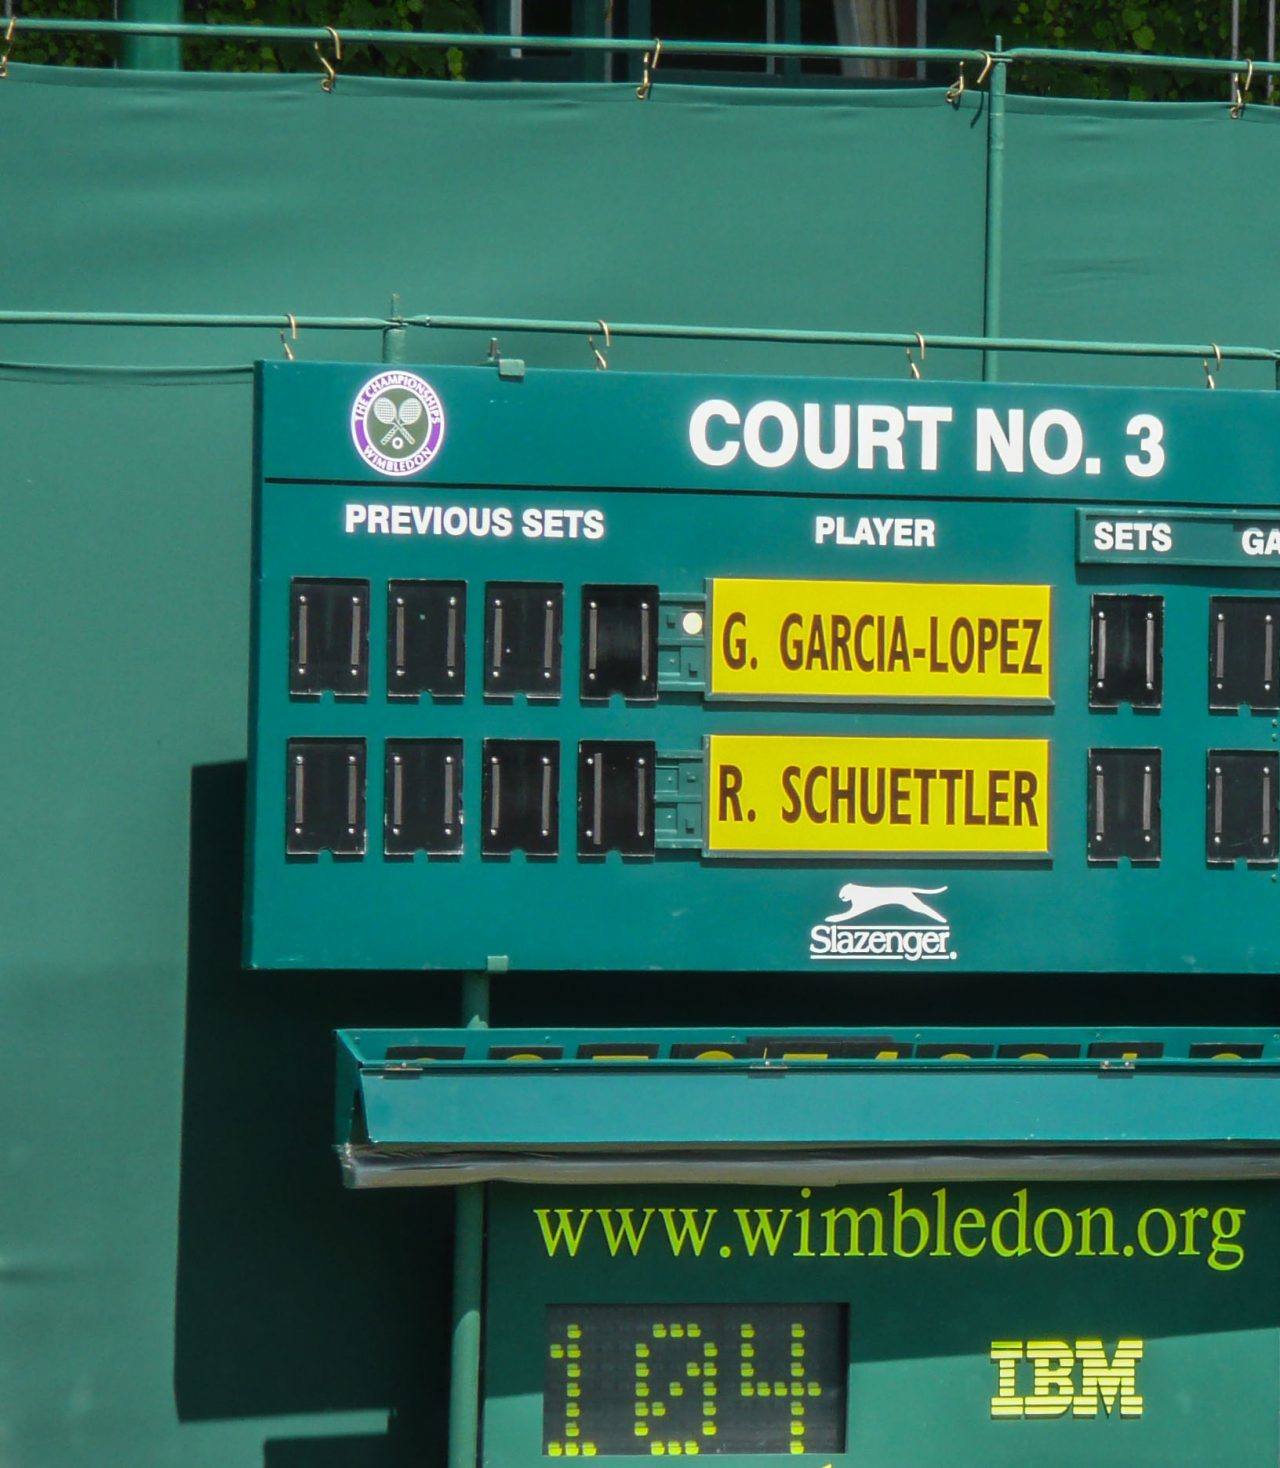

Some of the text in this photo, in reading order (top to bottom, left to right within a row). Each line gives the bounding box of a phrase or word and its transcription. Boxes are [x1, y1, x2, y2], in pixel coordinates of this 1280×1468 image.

[355, 373, 441, 424] THE CHAMPIONSHIPS
[363, 444, 434, 472] WIMBLEDON
[688, 398, 1166, 478] COURT NO. 3
[344, 503, 605, 540] PREVIOUS SETS
[814, 515, 936, 548] PLAYER
[1093, 521, 1173, 552] SETS
[722, 612, 1043, 676] G. GARCIA-LOPEZ
[718, 764, 1039, 828] R. SCHUETTLER
[533, 1186, 1246, 1271] www.wimbledon.org
[548, 1322, 823, 1456] 104
[990, 1340, 1144, 1417] IBM
